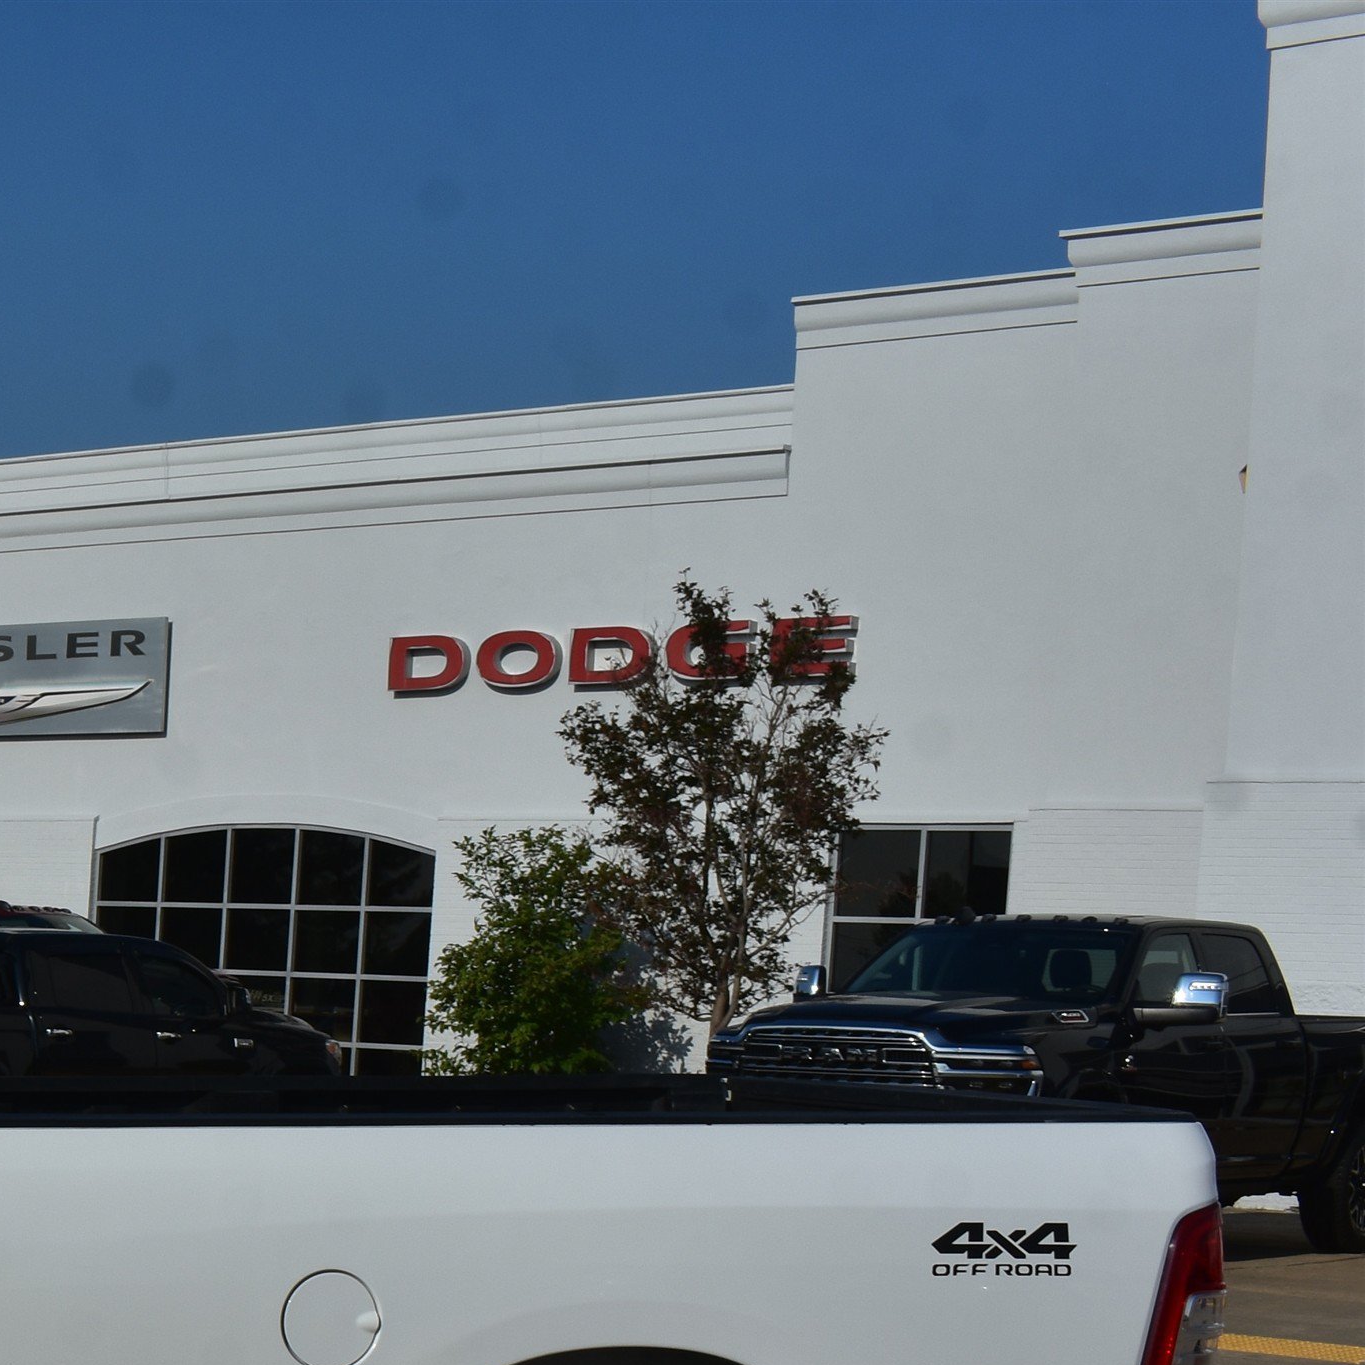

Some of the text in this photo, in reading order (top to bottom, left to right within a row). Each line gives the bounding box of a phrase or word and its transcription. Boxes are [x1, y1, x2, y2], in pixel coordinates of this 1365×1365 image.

[388, 614, 858, 692] DODGE
[932, 1263, 1072, 1277] OFF ROAD
